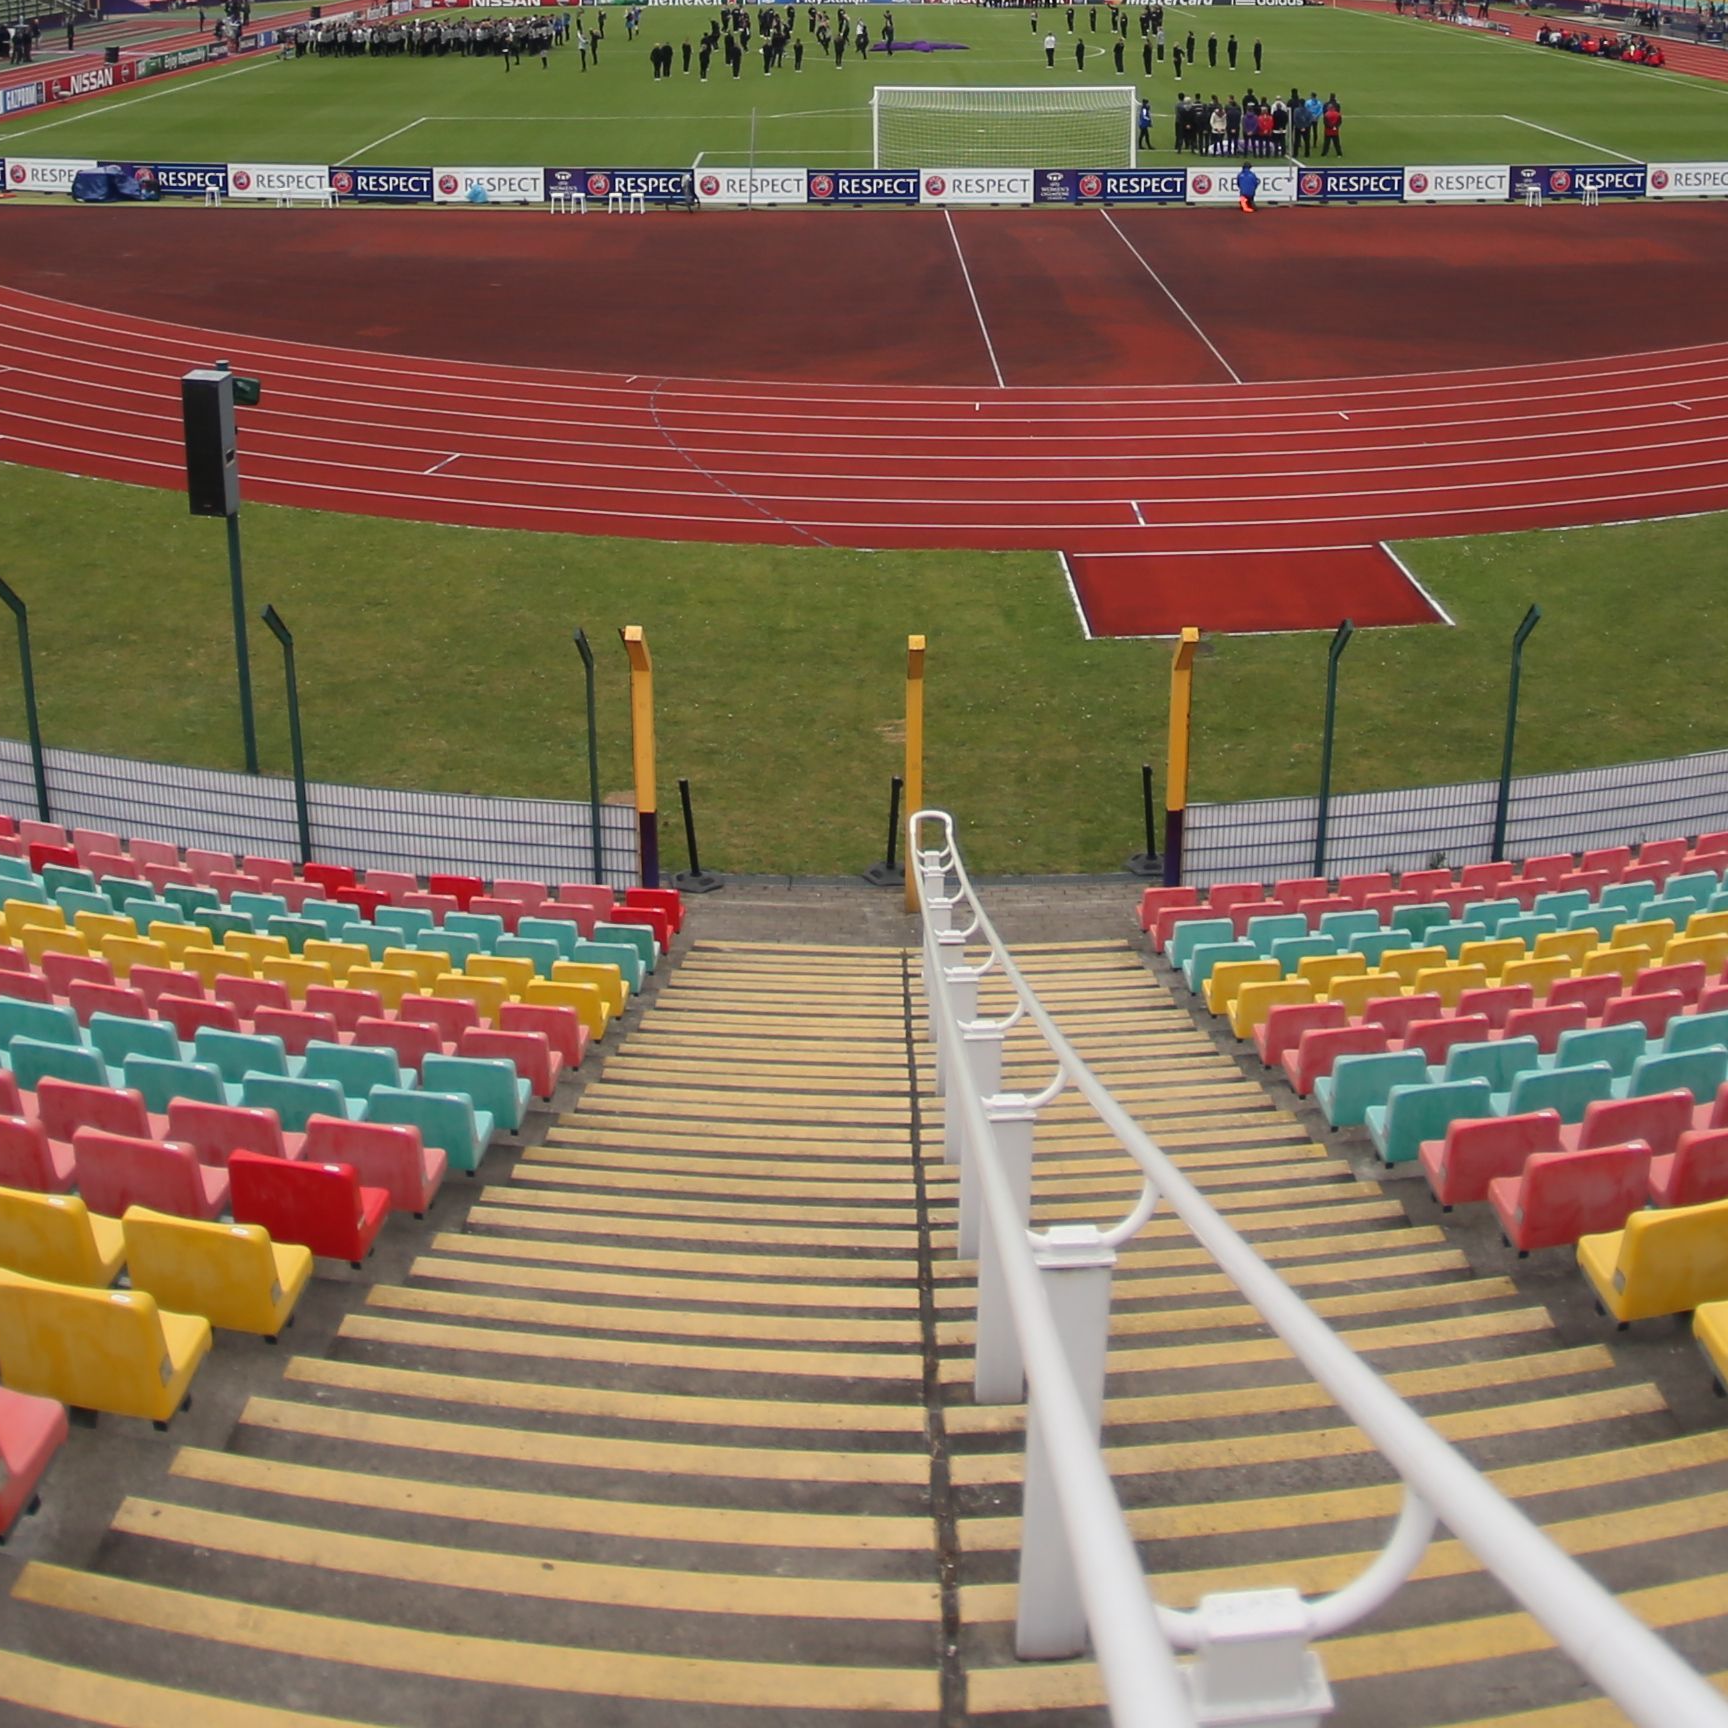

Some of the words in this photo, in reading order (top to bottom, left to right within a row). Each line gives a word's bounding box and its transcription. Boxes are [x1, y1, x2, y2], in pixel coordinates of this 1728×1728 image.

[70, 67, 114, 95] NISSAN
[31, 168, 83, 182] RESPE
[158, 170, 226, 188] RESPECT
[256, 174, 325, 190] RESPECT
[1435, 174, 1506, 191] RESPECT
[1575, 173, 1645, 189] RESPECT
[357, 176, 430, 192] RESPECT
[614, 177, 681, 193] RESPEC
[726, 178, 803, 194] RESPECT
[839, 178, 917, 194] RESPECT
[953, 178, 1030, 193] RESPECT
[1107, 178, 1184, 193] RESPECT
[1327, 176, 1402, 192] RESPECT
